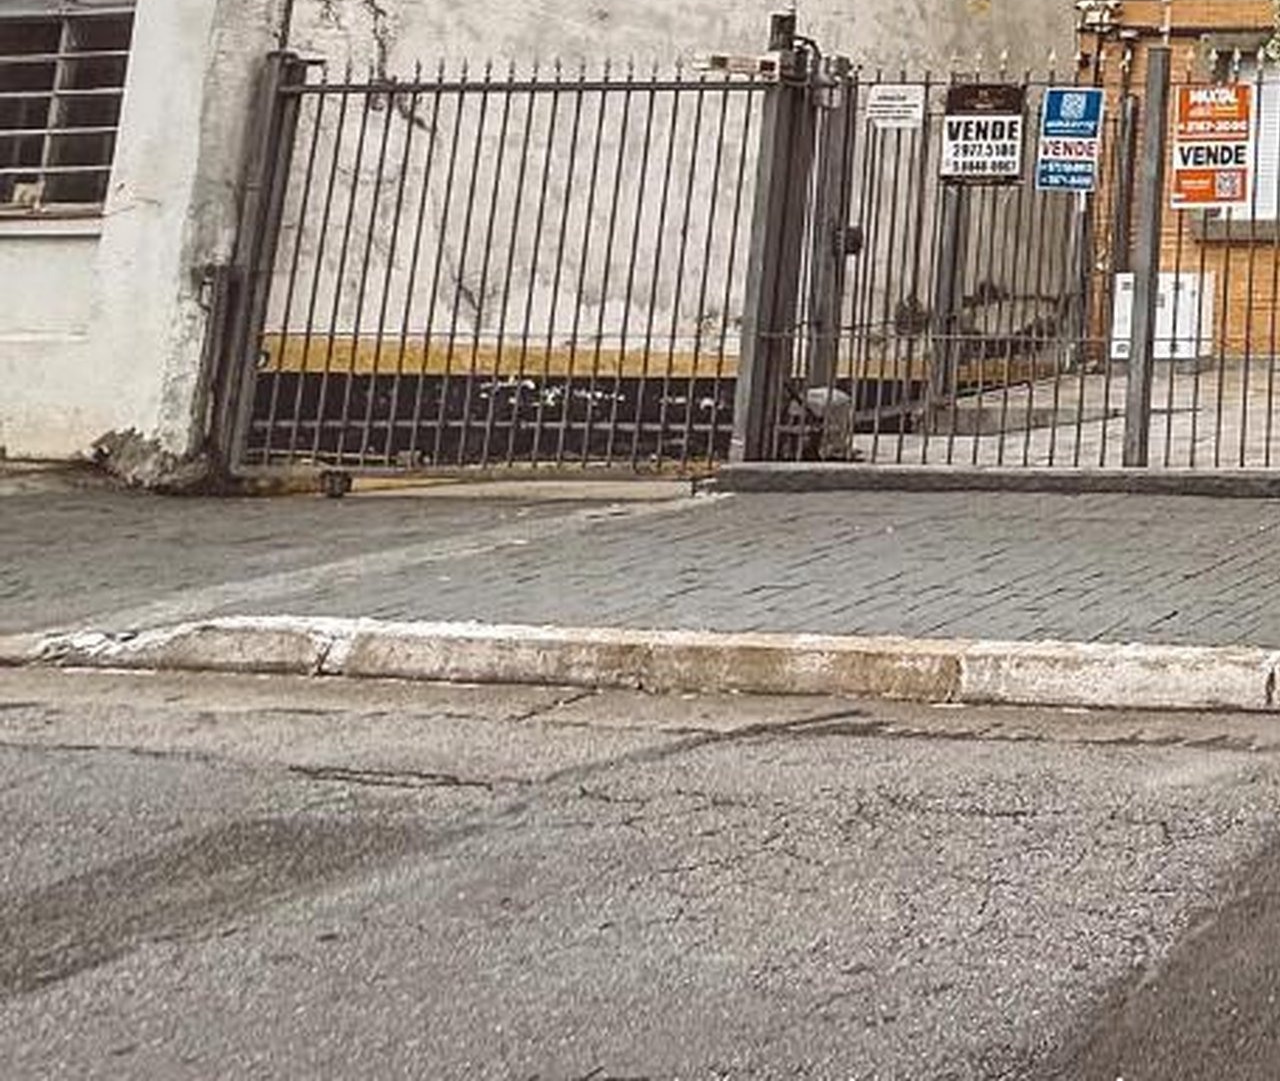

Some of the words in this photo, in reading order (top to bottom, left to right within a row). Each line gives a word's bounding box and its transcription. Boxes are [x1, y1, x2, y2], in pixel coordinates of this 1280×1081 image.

[947, 120, 1018, 141] VENDE
[1042, 140, 1096, 156] VENDE
[1178, 145, 1247, 166] VENDE
